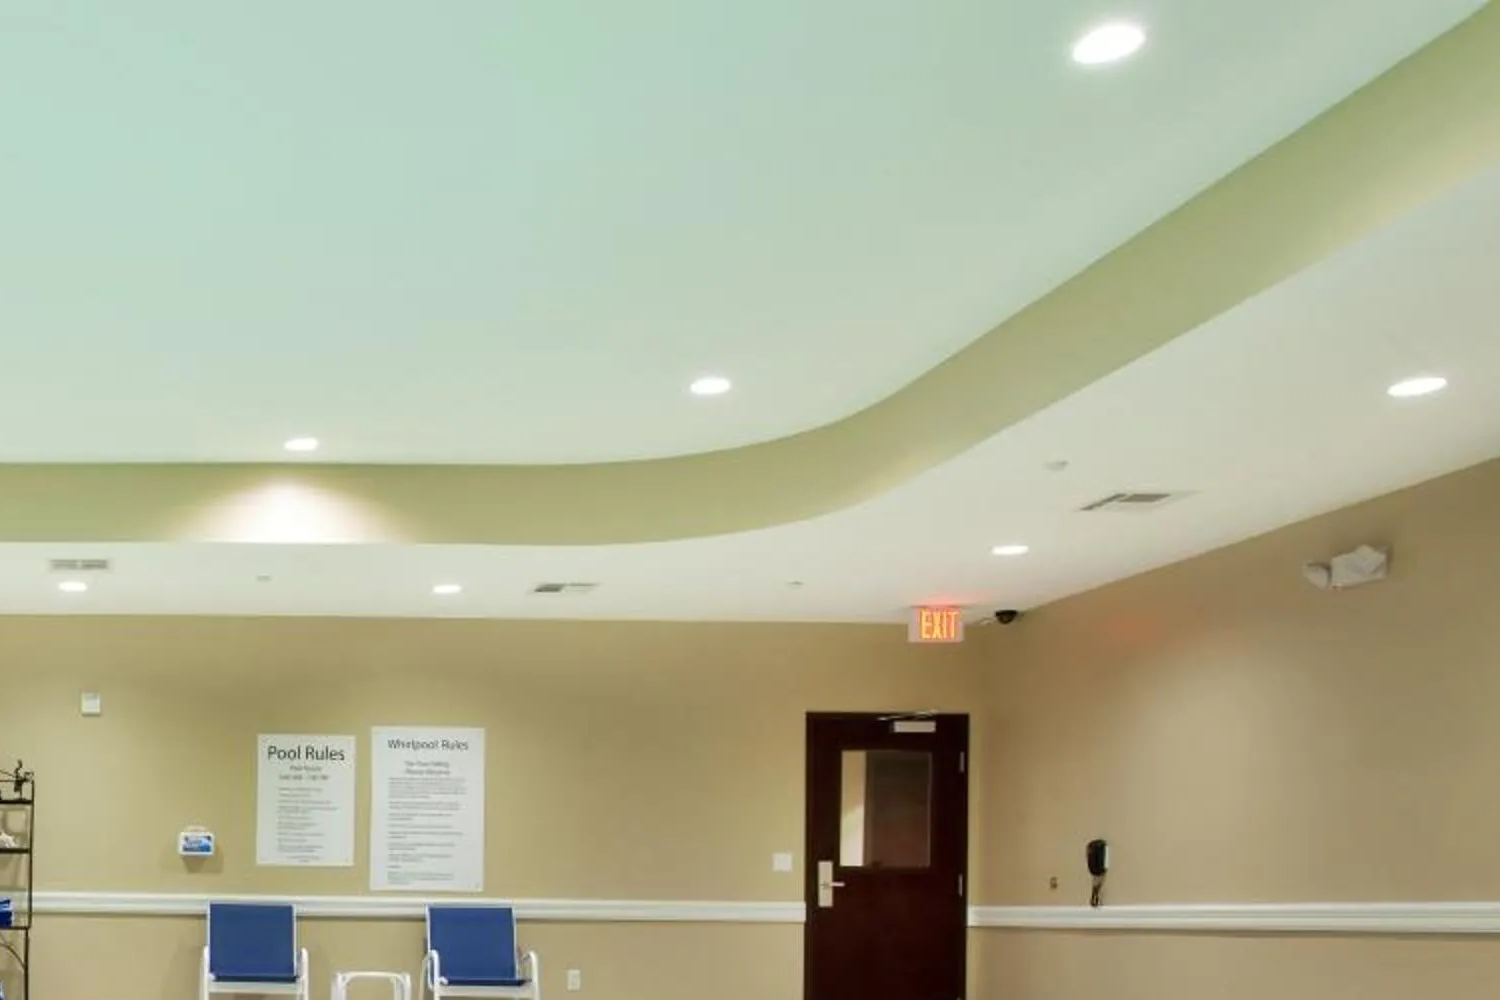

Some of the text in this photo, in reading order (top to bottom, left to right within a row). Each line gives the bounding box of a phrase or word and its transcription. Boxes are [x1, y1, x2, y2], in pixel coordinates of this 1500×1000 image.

[921, 611, 959, 639] EXIT
[267, 745, 345, 761] Pool Rules
[387, 739, 469, 751] Whirlpool Rules
